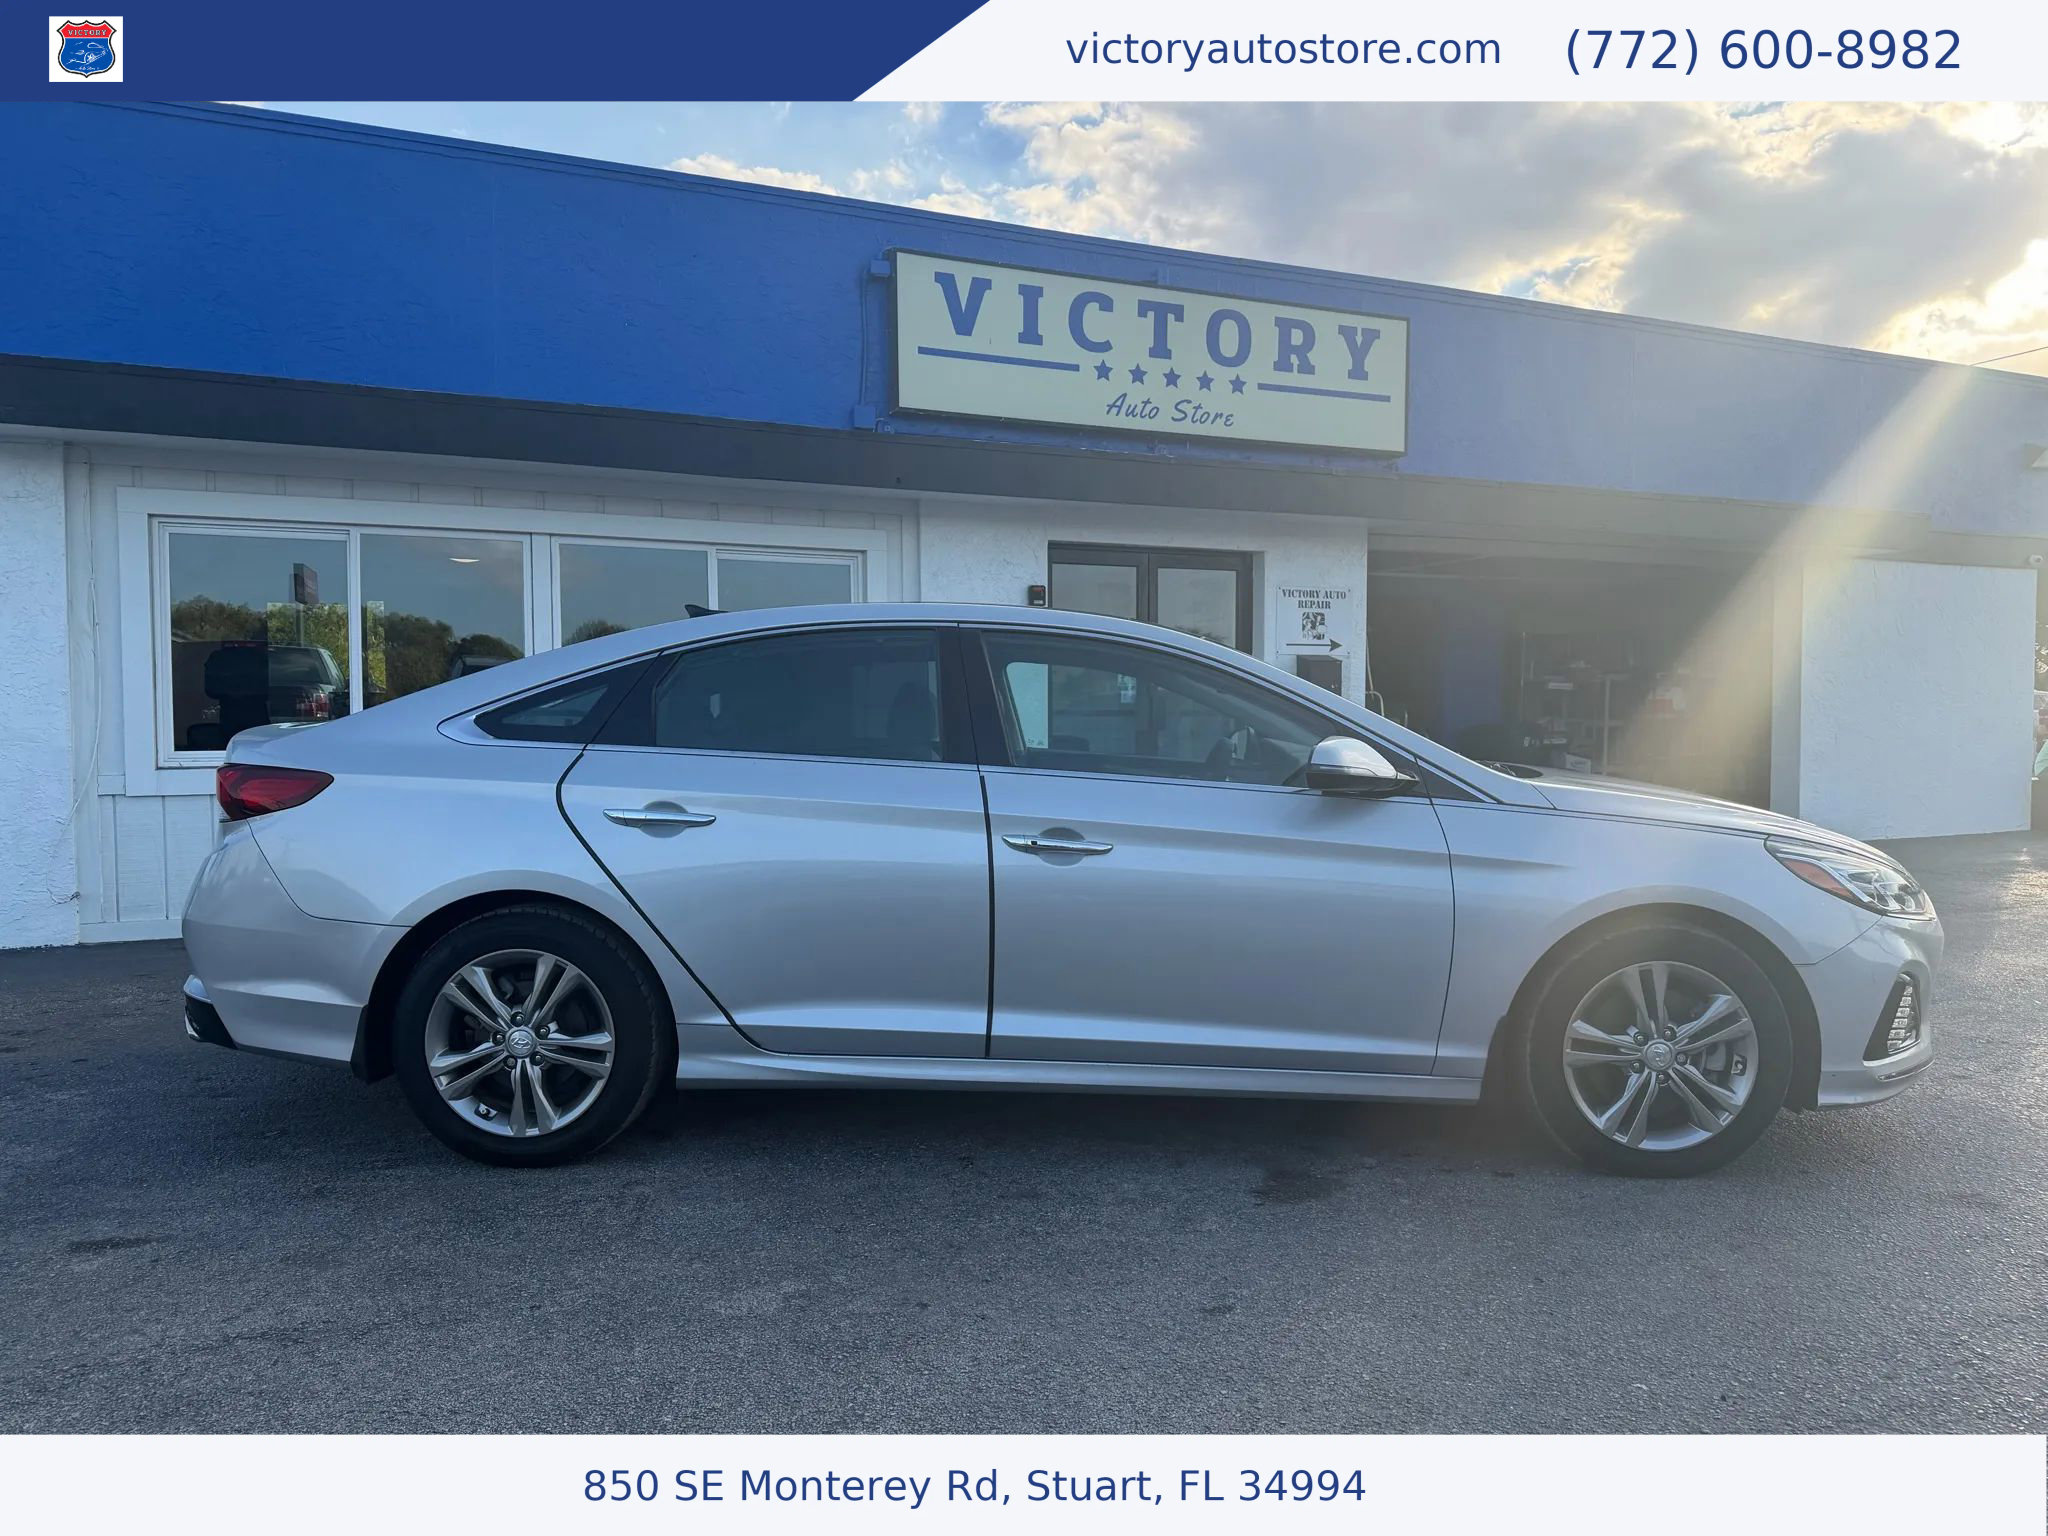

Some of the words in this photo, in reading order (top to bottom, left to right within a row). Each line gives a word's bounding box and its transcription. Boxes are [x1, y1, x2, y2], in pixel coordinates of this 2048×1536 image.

[934, 270, 1381, 382] VICTORY
[1105, 391, 1161, 421] Auto
[1170, 398, 1236, 428] Store
[1282, 589, 1321, 599] VICTORY
[1323, 590, 1347, 599] AUTO
[1298, 600, 1331, 609] REPAIR
